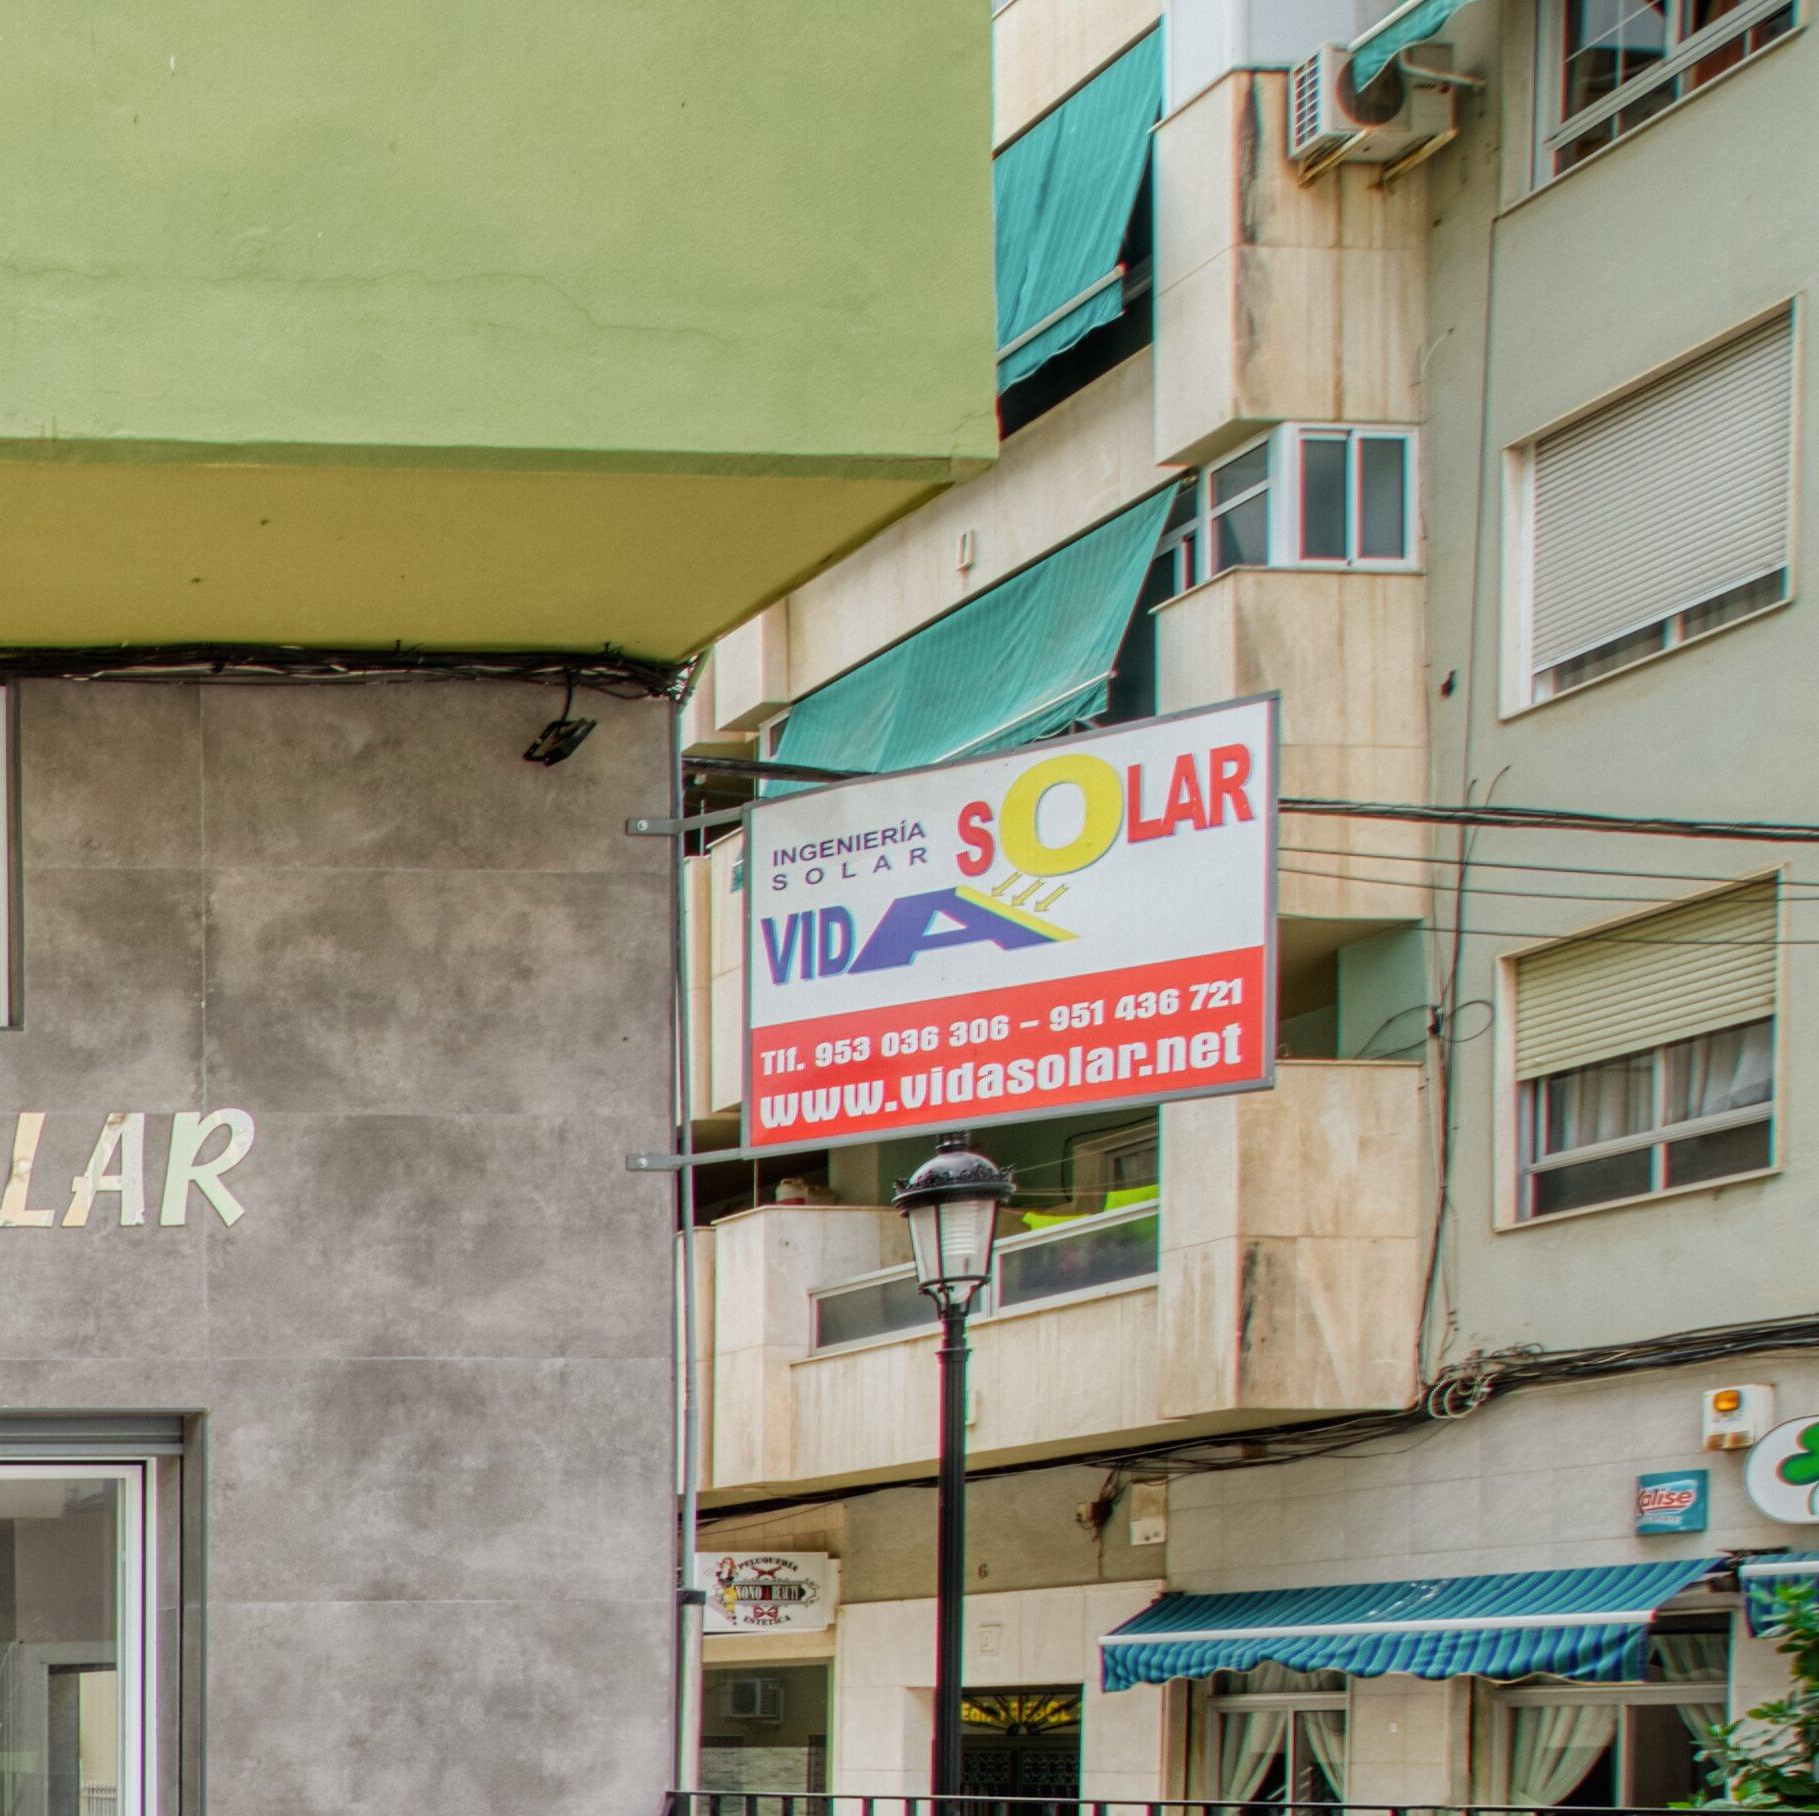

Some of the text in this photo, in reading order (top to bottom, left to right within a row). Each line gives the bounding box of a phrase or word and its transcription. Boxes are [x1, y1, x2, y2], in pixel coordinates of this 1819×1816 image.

[770, 820, 927, 868] INGENIERÍA
[955, 742, 1257, 878] SOLAR
[770, 847, 929, 892] SOLAR
[760, 886, 1081, 986] VIDA
[814, 1036, 871, 1069] 953
[880, 1027, 940, 1058] 036
[949, 1015, 1011, 1045] 306
[1049, 1002, 1106, 1034] 951
[1114, 989, 1181, 1022] 436
[1188, 976, 1245, 1011] 721
[759, 1022, 1243, 1131] www.vidasolar.net
